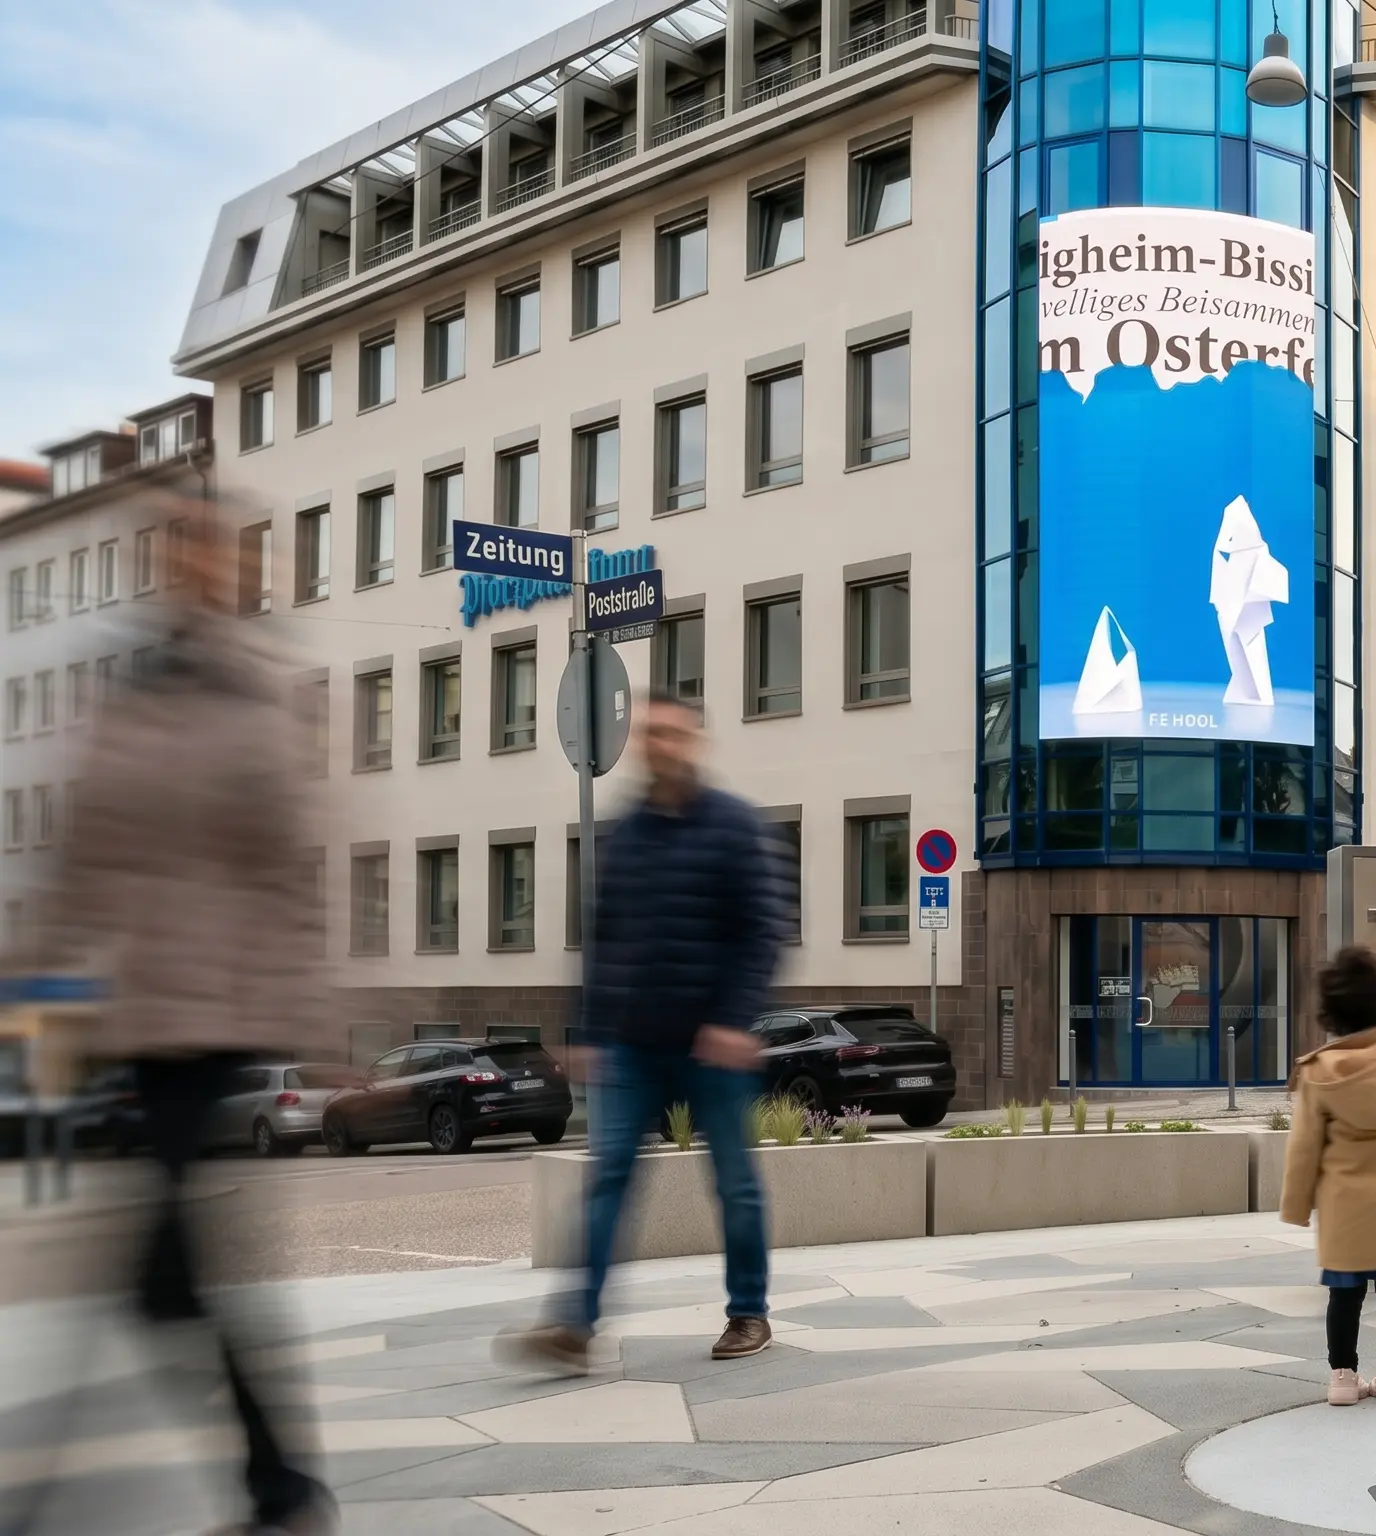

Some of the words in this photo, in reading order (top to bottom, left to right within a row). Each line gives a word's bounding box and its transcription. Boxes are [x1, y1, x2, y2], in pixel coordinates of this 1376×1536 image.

[1039, 233, 1314, 297] igheim-Bissi
[1042, 287, 1148, 321] velliges
[1156, 286, 1315, 335] Beisammen
[1039, 336, 1085, 373] m
[466, 531, 564, 576] Zeitung
[588, 580, 655, 619] Poststraße
[1149, 713, 1168, 727] FE
[1172, 713, 1218, 728] HOOL
